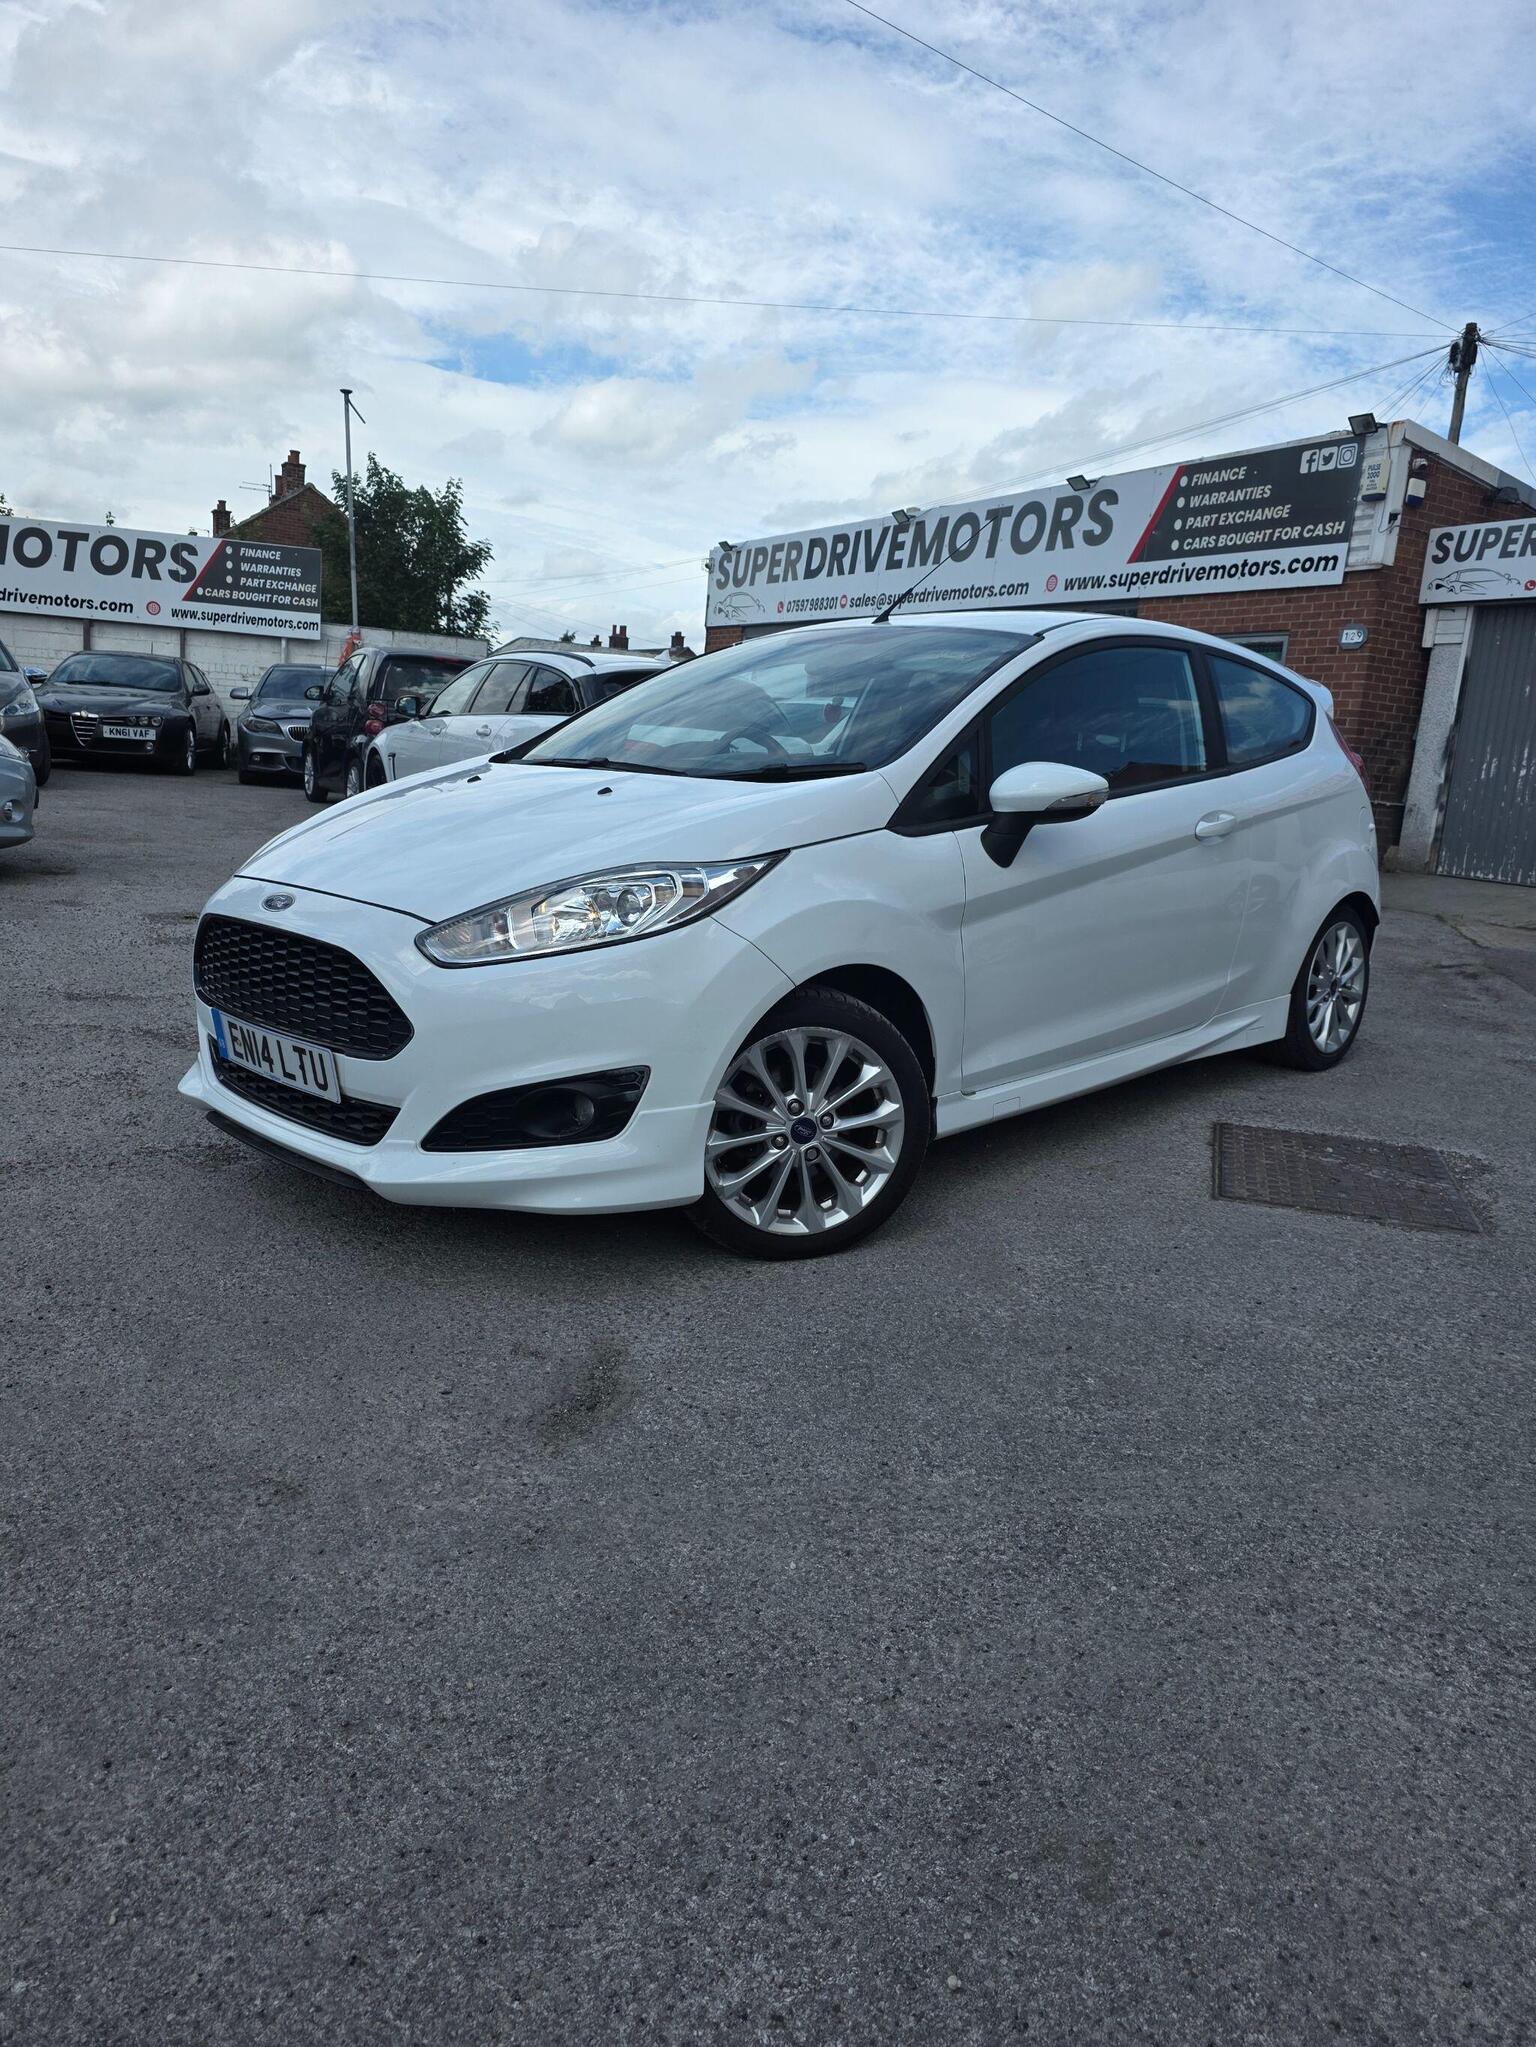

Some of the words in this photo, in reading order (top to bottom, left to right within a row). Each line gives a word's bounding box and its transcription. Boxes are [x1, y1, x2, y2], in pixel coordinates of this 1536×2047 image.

[1191, 466, 1247, 487] FINANCE
[1189, 485, 1272, 508] WARRANTIES
[1185, 513, 1218, 530] PART
[1219, 504, 1292, 526] EXCHANGE
[1183, 535, 1216, 551] CARS
[1217, 529, 1271, 547] BOUGHT
[1273, 526, 1301, 542] FOR
[1303, 521, 1346, 538] CASH
[0, 524, 199, 584] OTORS
[240, 547, 281, 560] FINANCE
[240, 562, 302, 577] WARRANTIES
[1064, 554, 1339, 592] www.superdrivemotors.com
[240, 577, 266, 589] PART
[266, 579, 317, 593] EXCHANGE
[205, 588, 231, 599] CARS
[232, 591, 272, 603] BOUGHT
[272, 595, 291, 605] FOR
[292, 596, 319, 608] CASH
[171, 608, 319, 631] www.superdrivemotors.com
[1345, 631, 1362, 641] 129
[109, 727, 131, 737] KN61
[132, 729, 150, 738] VAF
[227, 1020, 274, 1074] EN14
[276, 1040, 328, 1092] LTU
